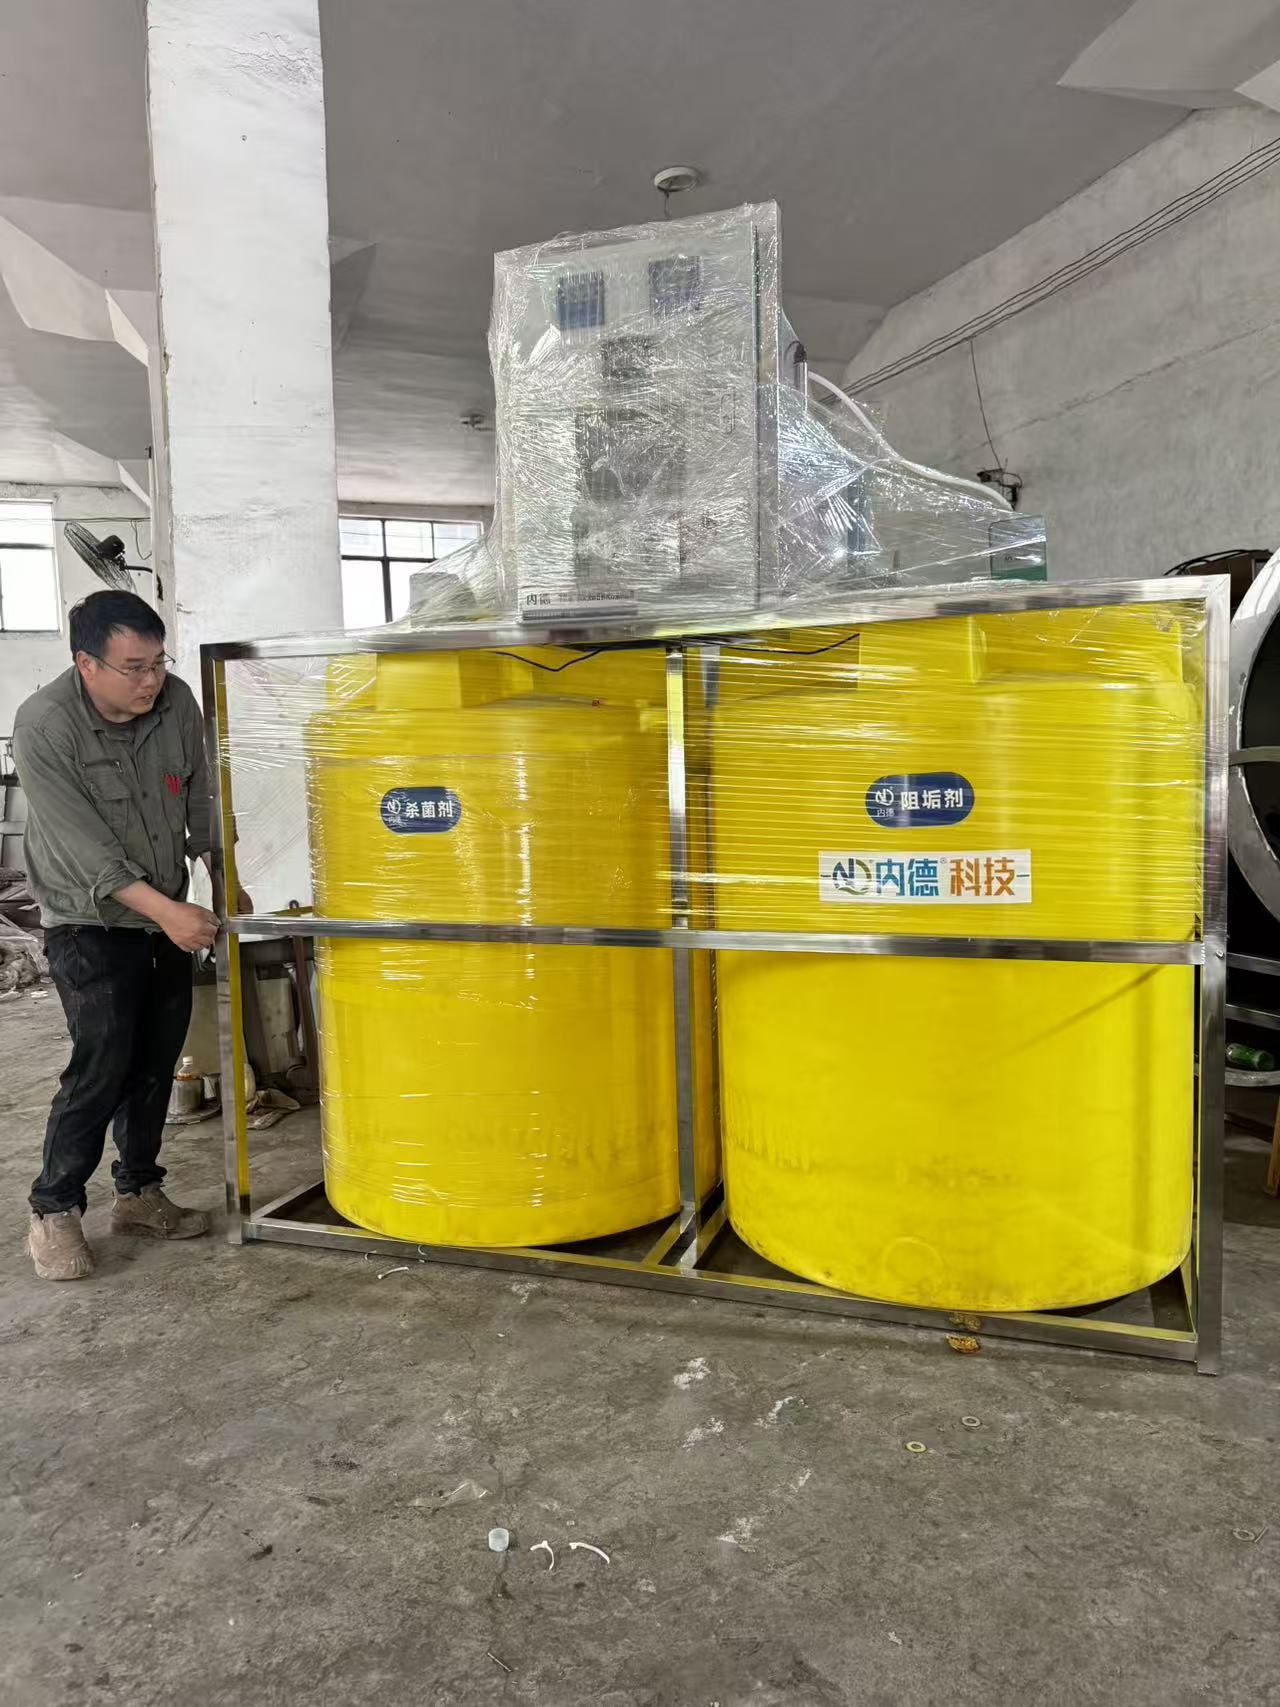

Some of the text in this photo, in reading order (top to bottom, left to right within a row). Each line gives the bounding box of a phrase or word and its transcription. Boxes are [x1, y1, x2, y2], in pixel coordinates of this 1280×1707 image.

[405, 800, 454, 819] 杀菌剂
[901, 787, 964, 811] 阻垢剂
